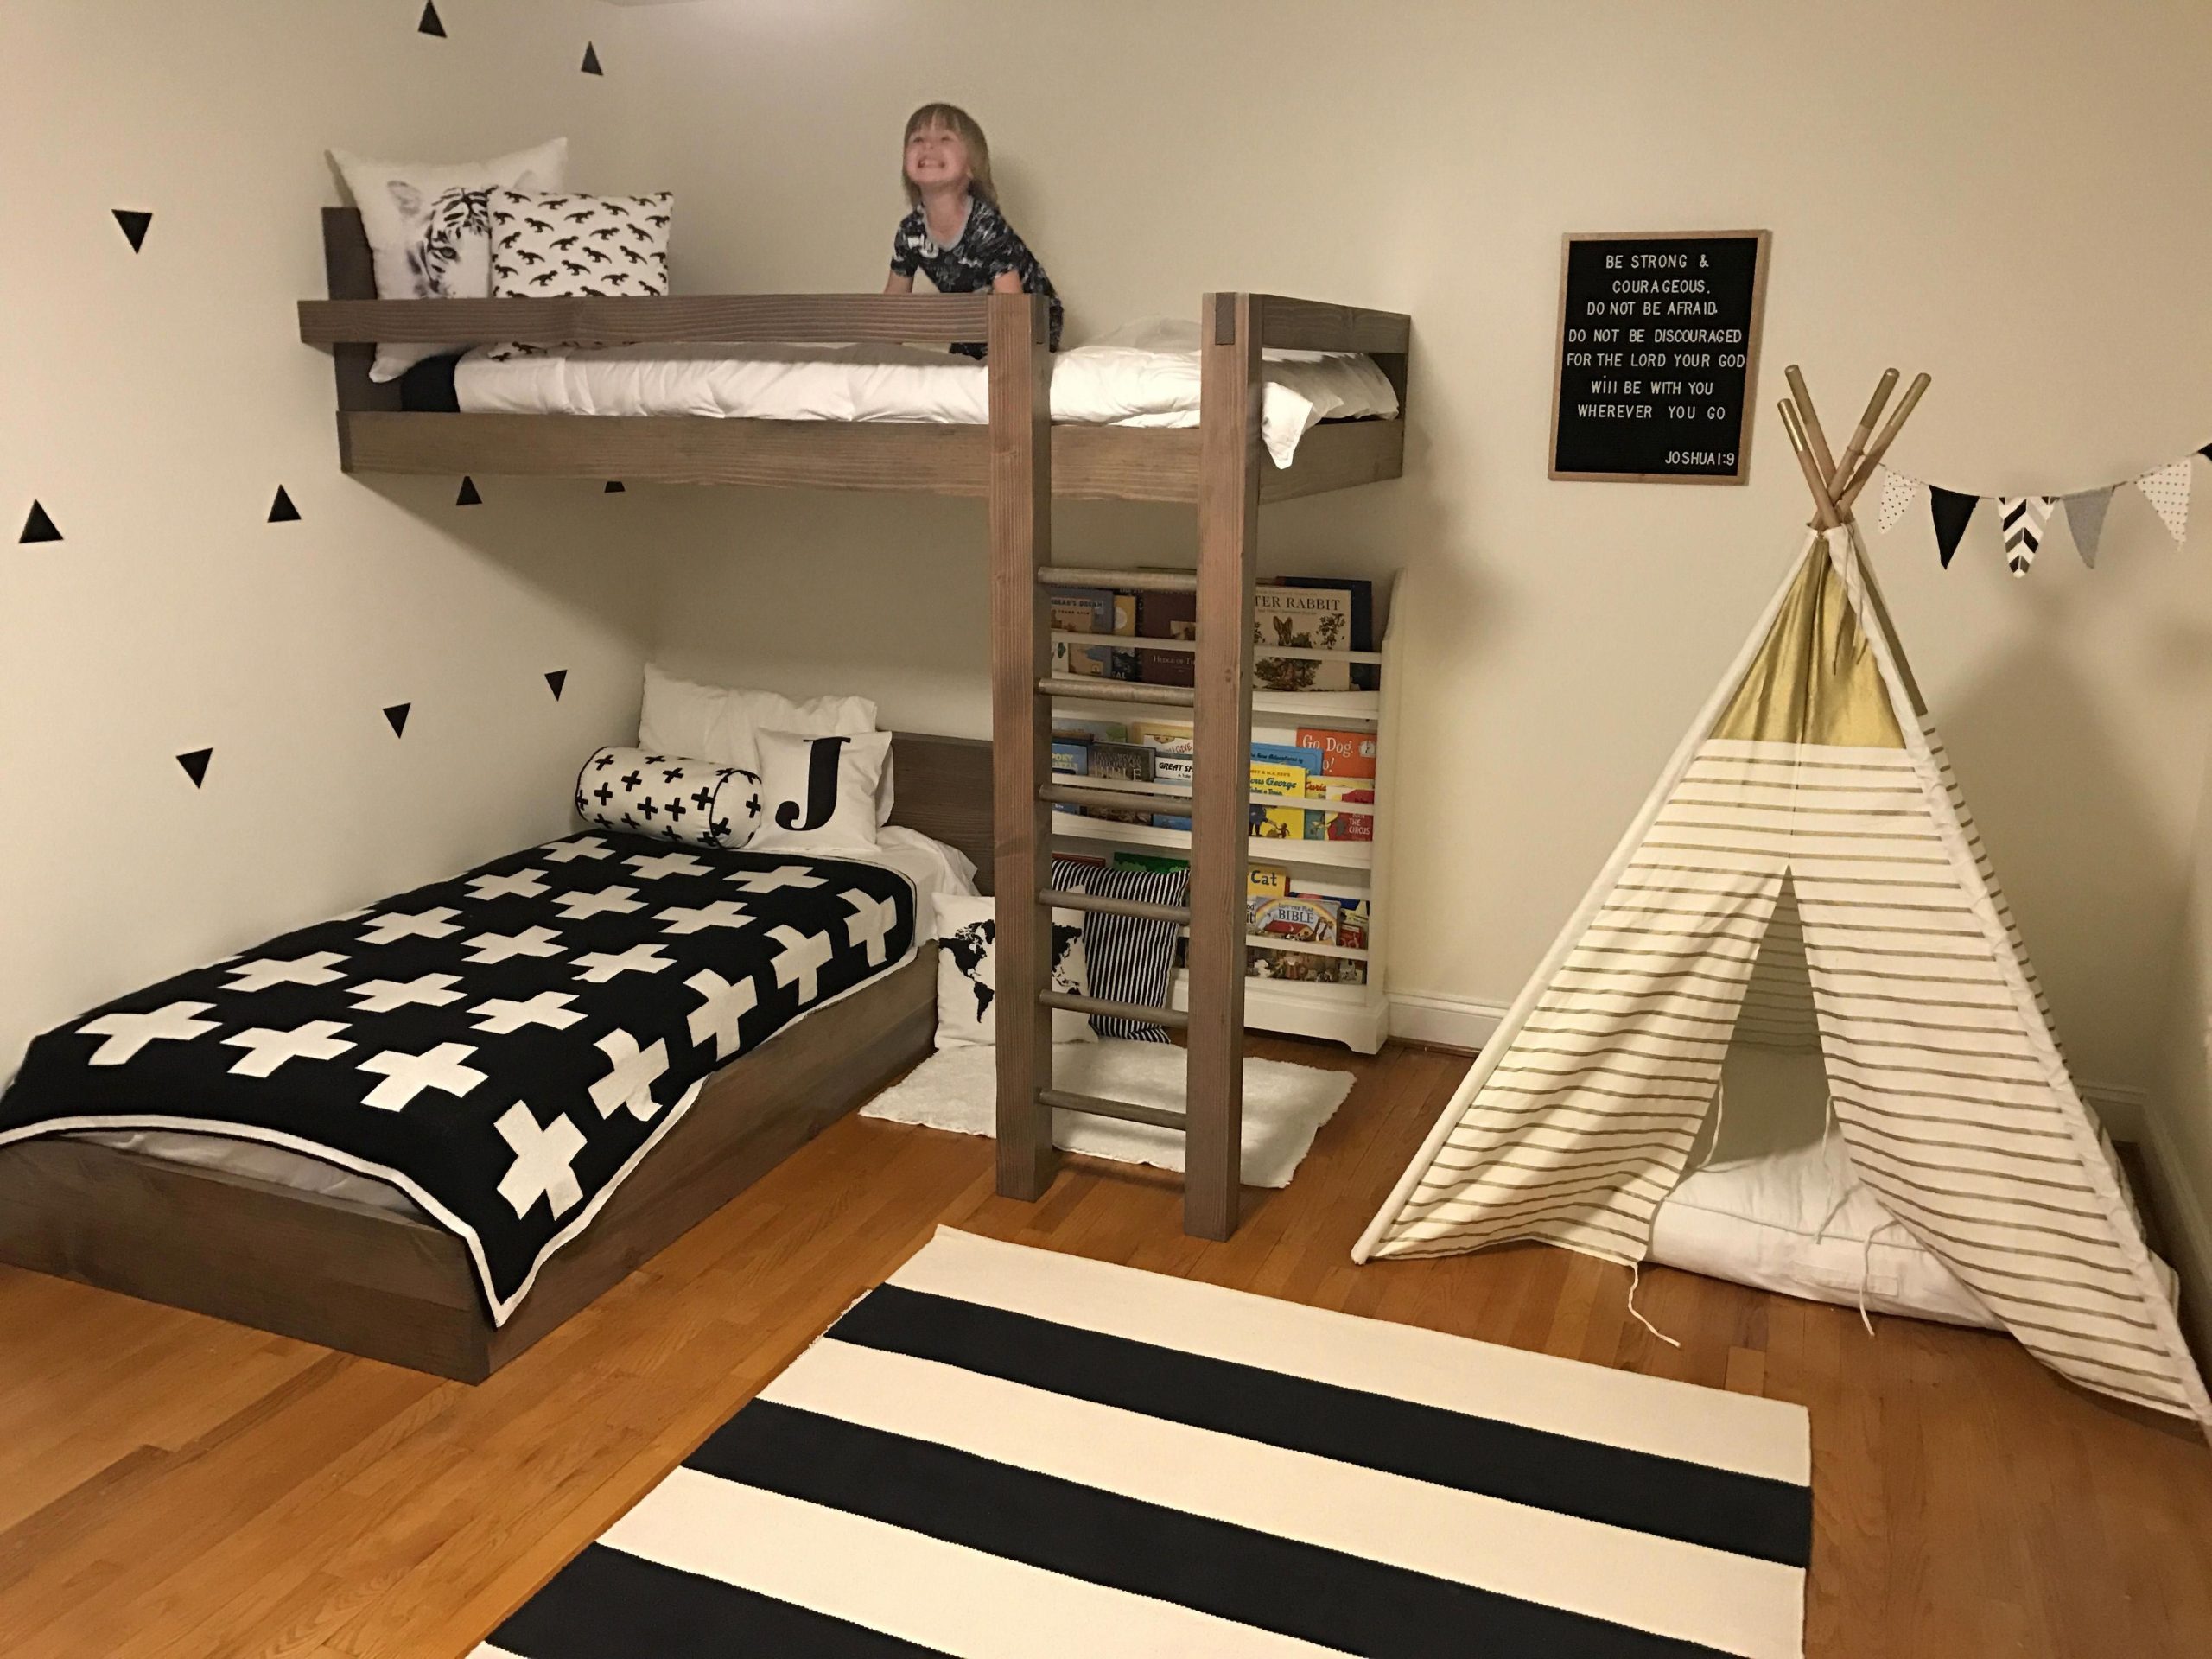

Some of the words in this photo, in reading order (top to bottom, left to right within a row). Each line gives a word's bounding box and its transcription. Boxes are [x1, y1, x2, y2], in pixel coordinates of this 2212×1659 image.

[1605, 255, 1624, 269] BE
[1630, 254, 1688, 269] STRONG
[1699, 254, 1709, 268] &
[1612, 280, 1711, 295] COURAGEOUS.
[1586, 302, 1605, 315] DO
[1609, 302, 1636, 315] NOT
[1643, 302, 1661, 315] BE
[1667, 302, 1719, 315] AFRAID.
[1568, 329, 1586, 342] DO
[1593, 329, 1620, 342] NOT
[1629, 329, 1645, 343] BE
[1654, 329, 1742, 343] DISCOURAGED
[1567, 353, 1592, 367] FOR
[1597, 353, 1623, 367] THE
[1630, 353, 1666, 367] LORD
[1674, 353, 1710, 367] YOUR
[1718, 354, 1745, 368] GOD
[1624, 381, 1642, 395] BE
[1650, 381, 1681, 395] WITH
[1688, 382, 1713, 396] YOU
[1577, 404, 1653, 419] WHEREVER
[1668, 406, 1696, 420] YOU
[1707, 406, 1726, 420] GO
[1255, 594, 1281, 607] TER
[1286, 596, 1341, 611] RABBIT
[1303, 734, 1320, 749] Go
[1159, 762, 1184, 772] GREAT
[774, 735, 852, 832] J
[1266, 777, 1297, 791] George
[1348, 825, 1370, 836] CIRCUS
[1250, 870, 1278, 887] Cat
[1278, 908, 1314, 924] BIBLE
